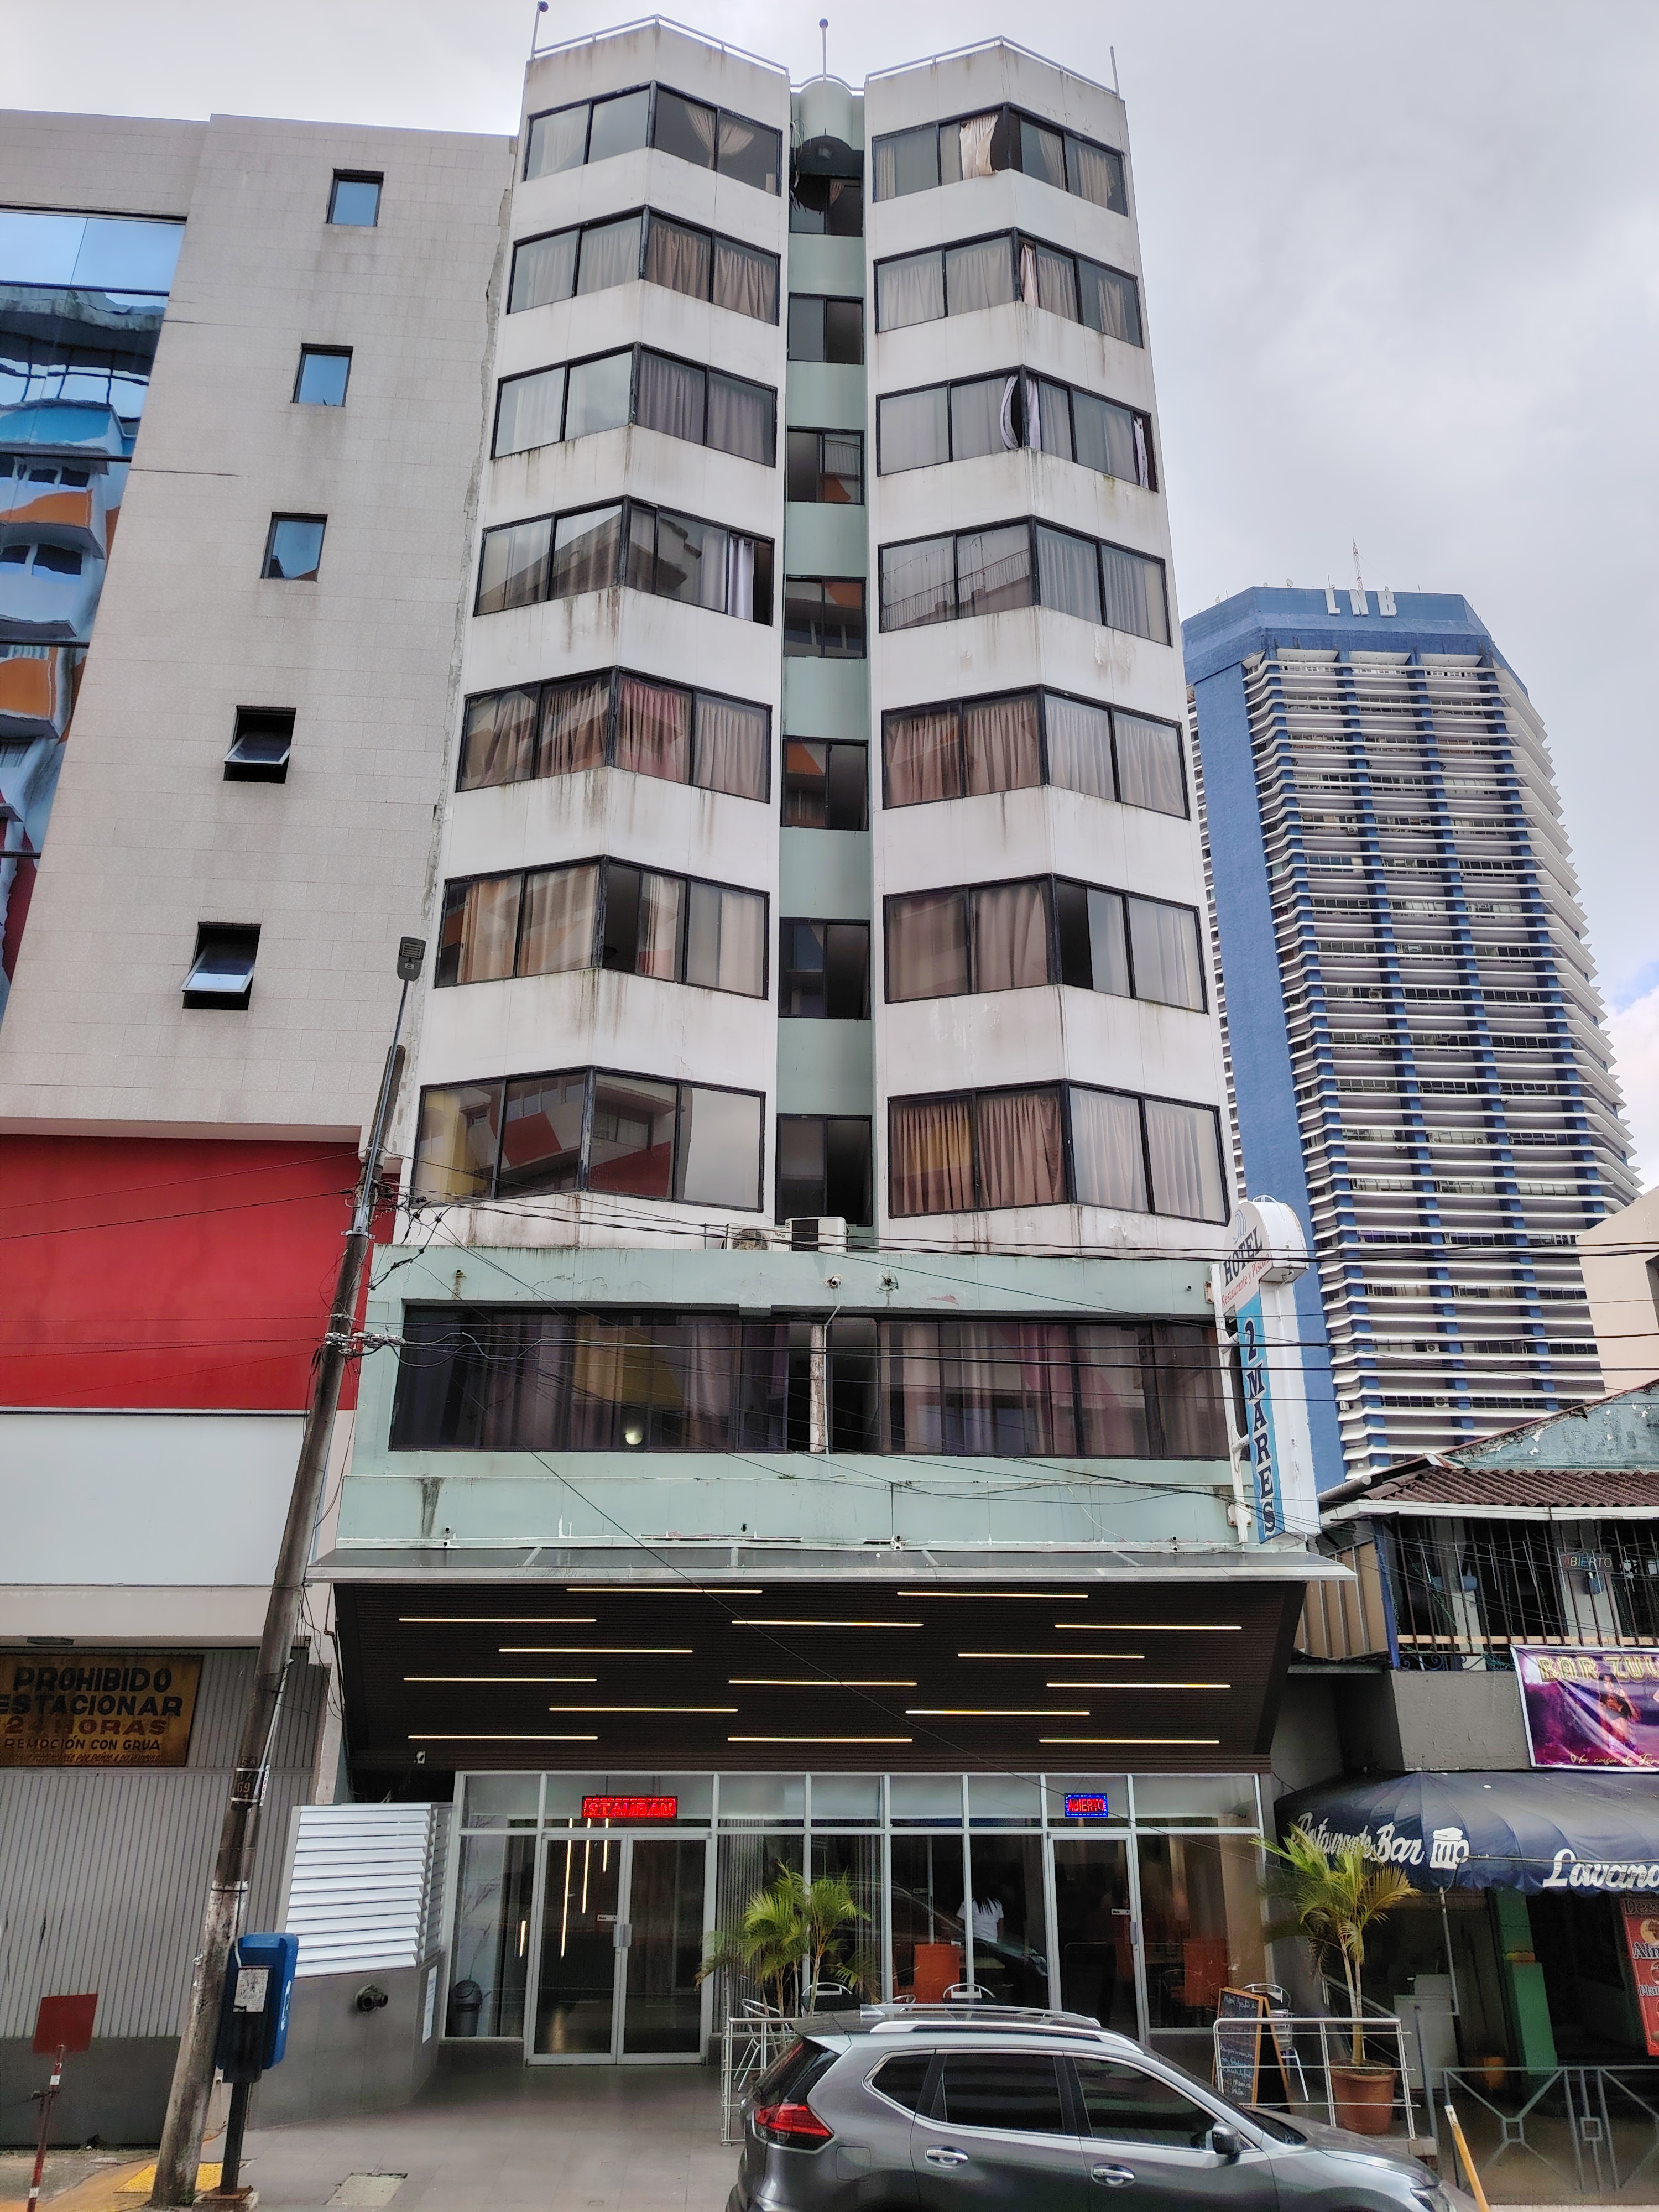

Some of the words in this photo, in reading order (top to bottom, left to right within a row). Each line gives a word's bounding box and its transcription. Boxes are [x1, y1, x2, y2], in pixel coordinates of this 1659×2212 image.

[1325, 588, 1397, 617] LNB
[1223, 1226, 1262, 1287] HOTEL
[1222, 1274, 1248, 1307] Restaurante
[1245, 1319, 1256, 1361] 2
[1562, 1556, 1613, 1568] ABIERTO
[13, 1667, 172, 1693] PROHIBIDO
[1536, 1656, 1599, 1682] BAR
[55, 1719, 167, 1735] HORAS
[90, 1738, 118, 1750] CON
[122, 1739, 161, 1751] GRUA
[1068, 1799, 1105, 1812] ABIERTO
[1376, 1822, 1425, 1865] Bar
